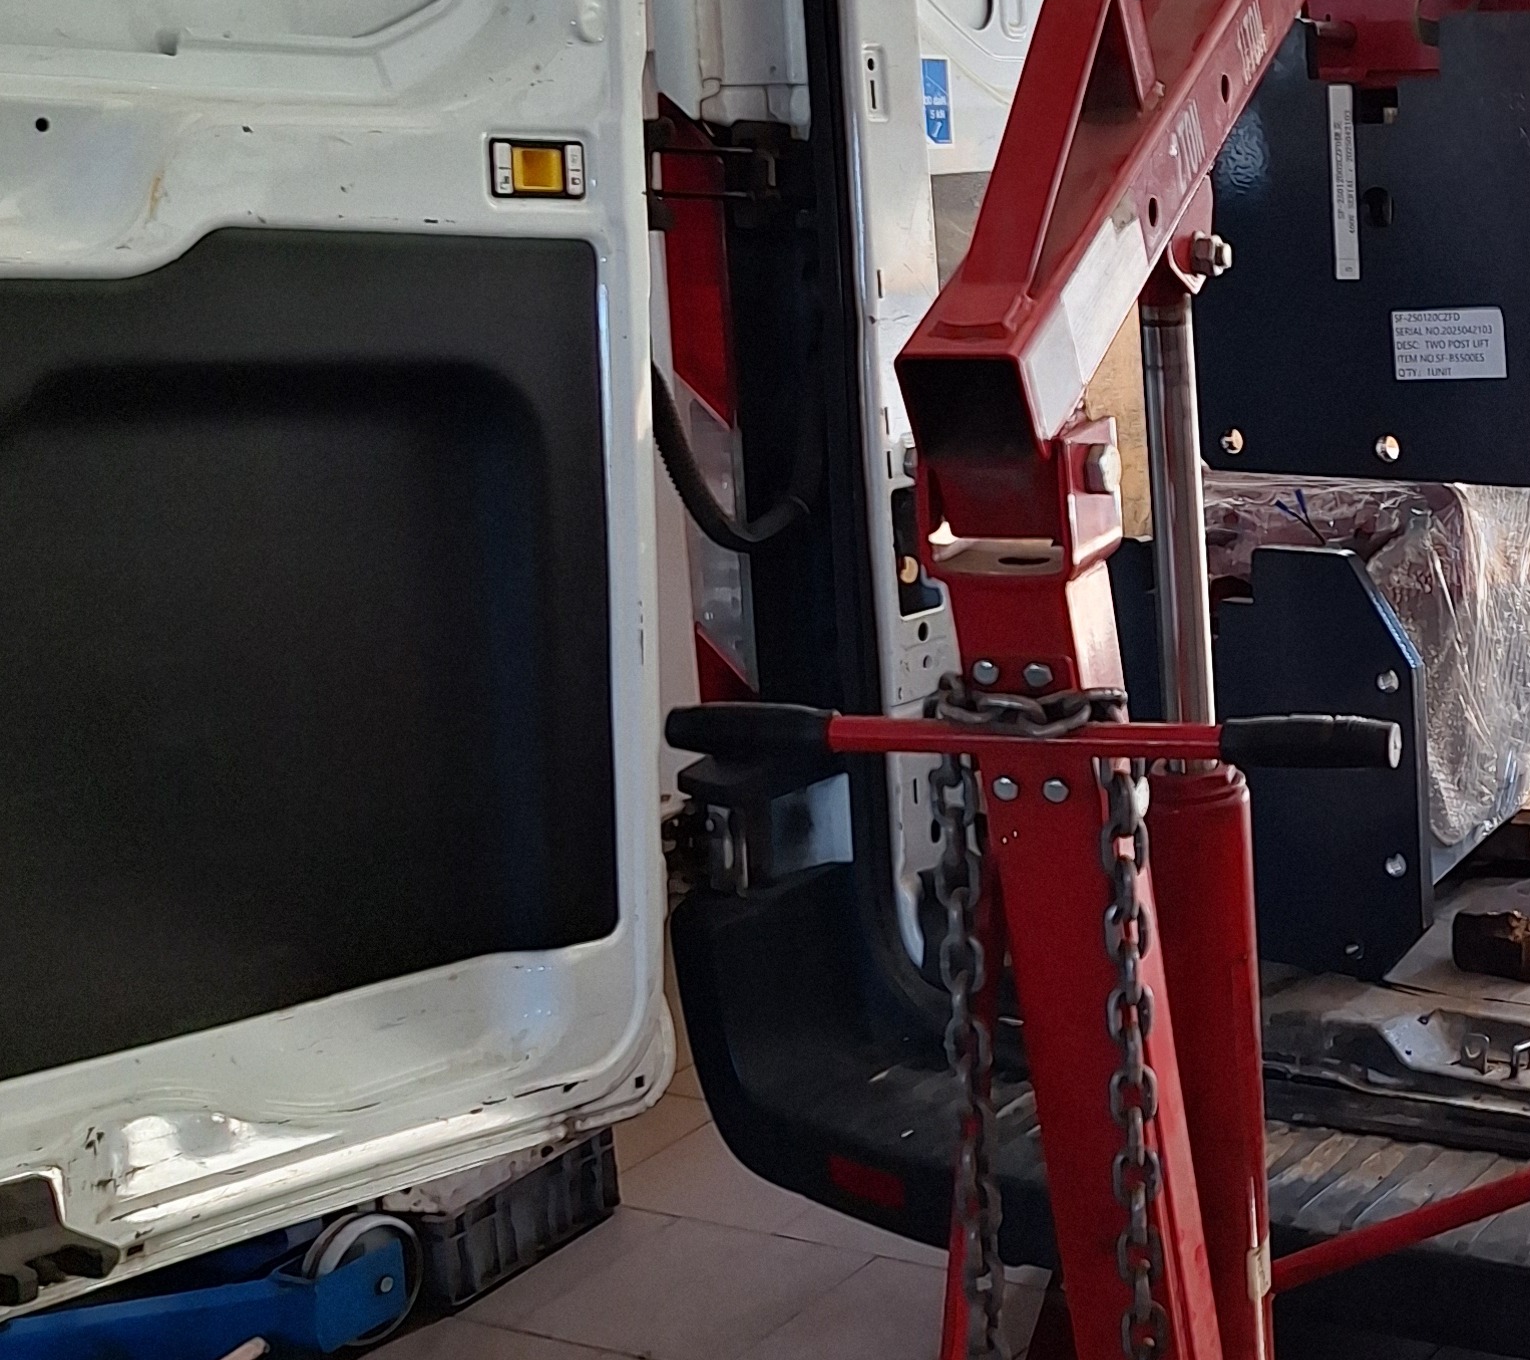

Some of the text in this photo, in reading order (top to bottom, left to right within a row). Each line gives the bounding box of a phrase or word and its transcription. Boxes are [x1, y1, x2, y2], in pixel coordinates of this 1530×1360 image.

[1395, 327, 1423, 336] SERIAL
[1425, 339, 1446, 349] TWO
[1448, 339, 1470, 349] POST
[1472, 339, 1489, 348] LIFT
[1397, 354, 1418, 363] ITEM
